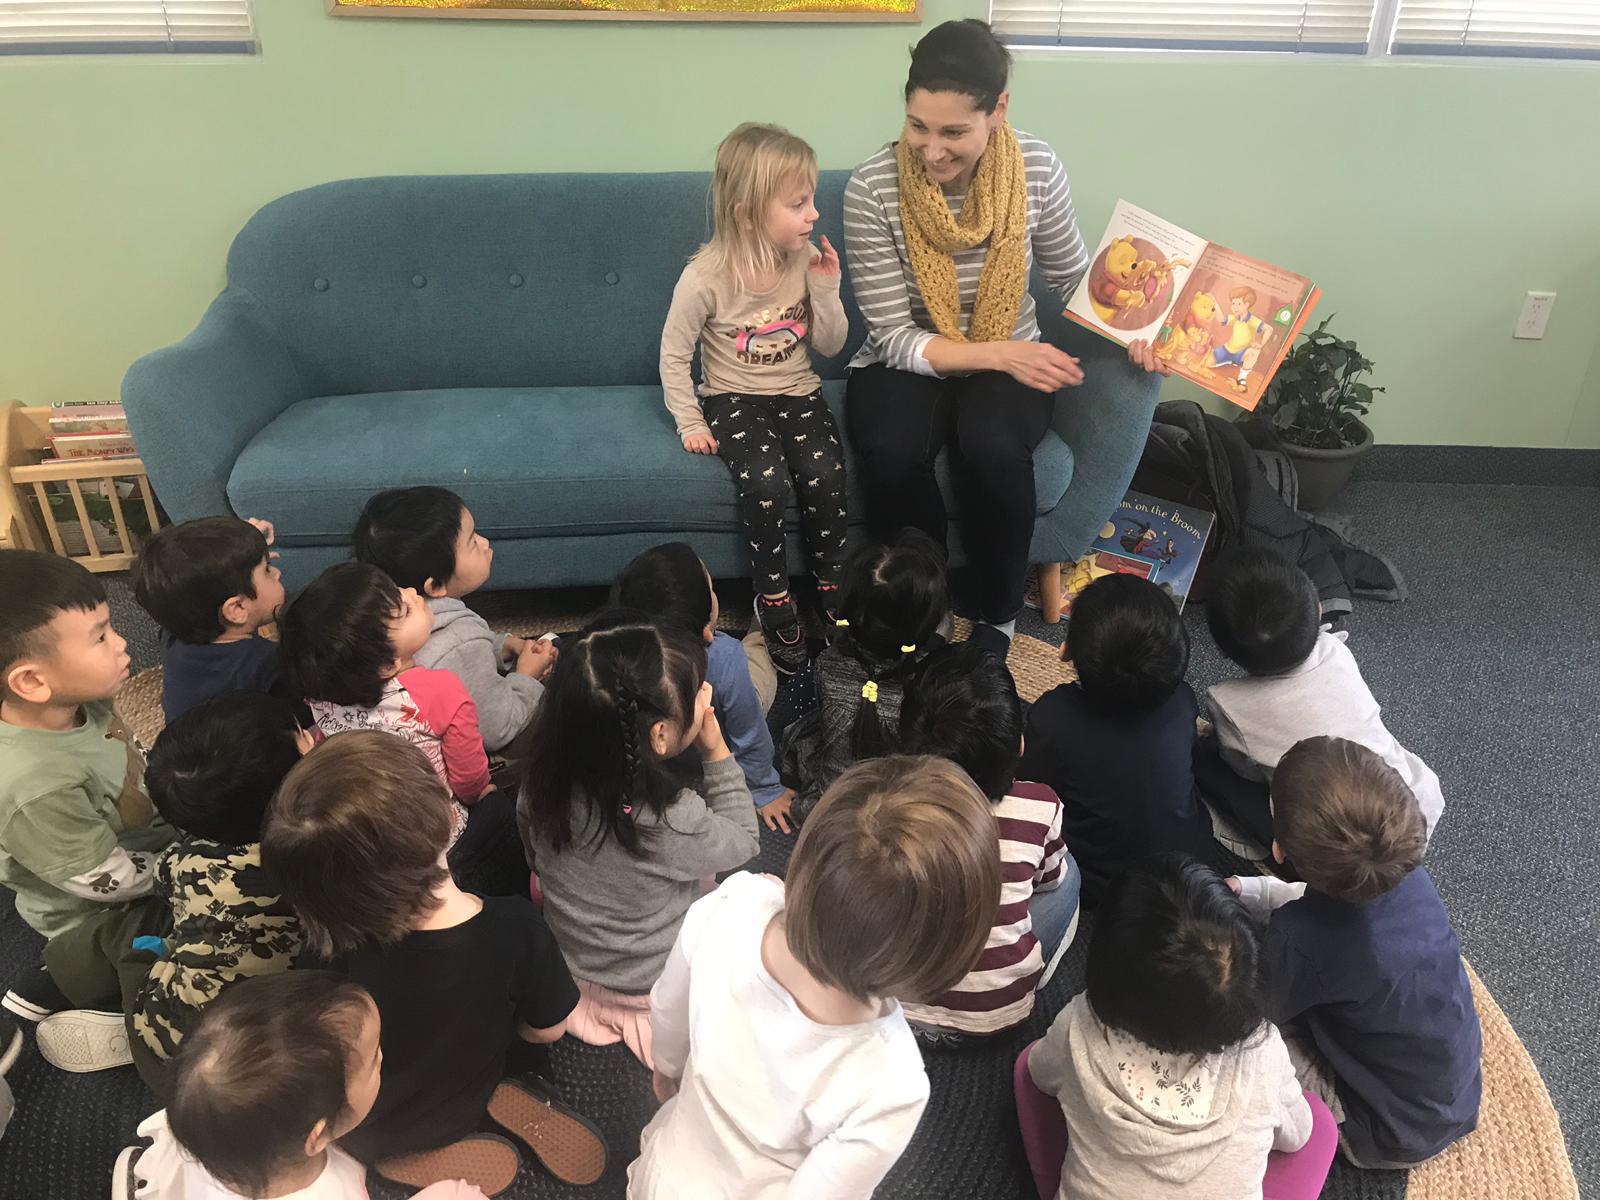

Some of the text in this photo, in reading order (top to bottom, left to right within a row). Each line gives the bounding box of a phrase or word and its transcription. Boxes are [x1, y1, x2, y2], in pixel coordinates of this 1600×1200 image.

[1135, 503, 1149, 513] on
[1151, 504, 1169, 518] the
[1170, 511, 1202, 540] Broom
